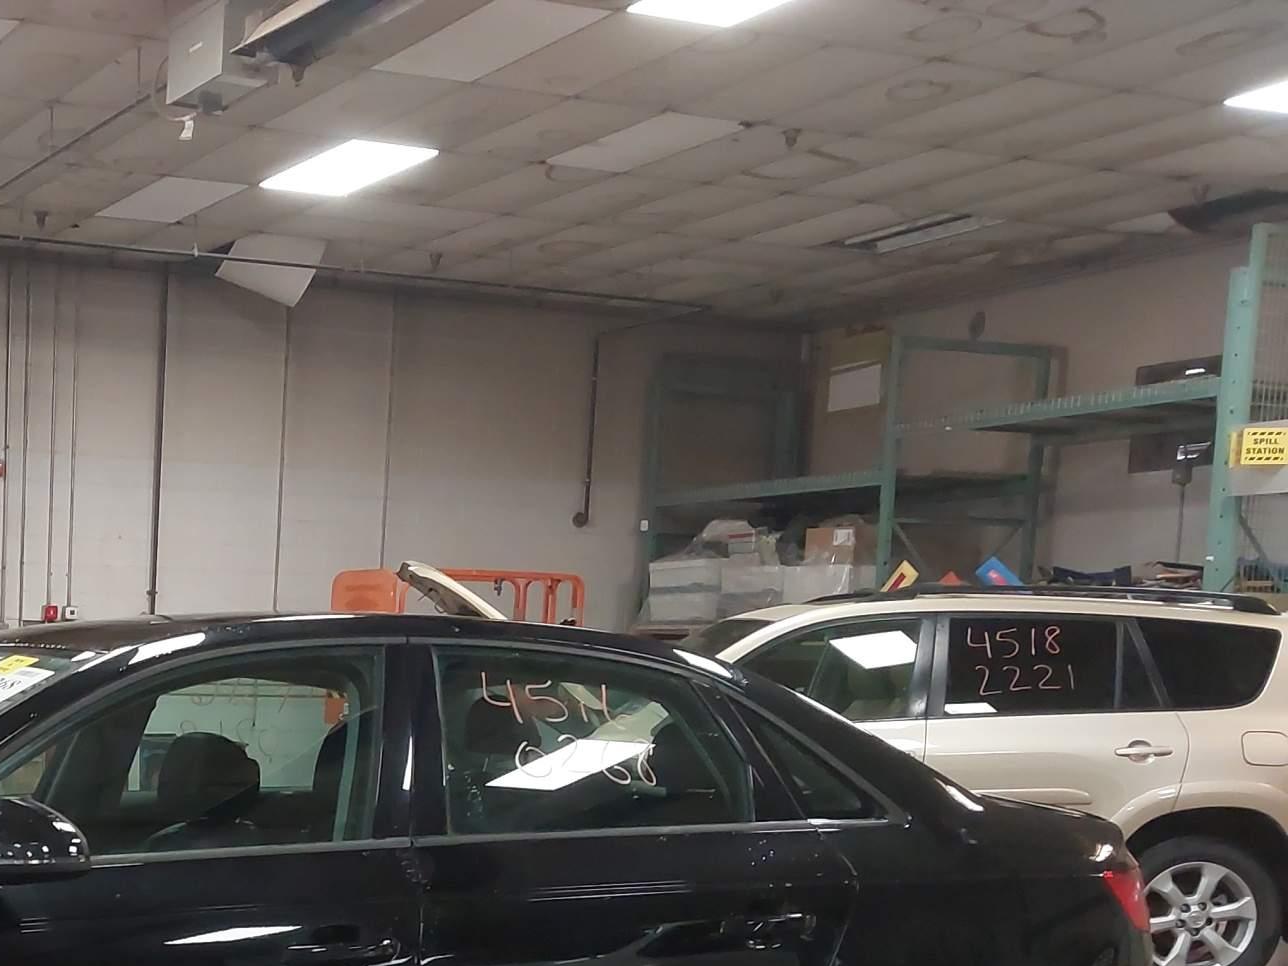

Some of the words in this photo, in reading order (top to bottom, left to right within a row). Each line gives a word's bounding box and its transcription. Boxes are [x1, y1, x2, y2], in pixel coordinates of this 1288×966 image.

[1246, 447, 1285, 455] STATION
[966, 625, 1061, 659] 4518
[975, 663, 1075, 696] 2221
